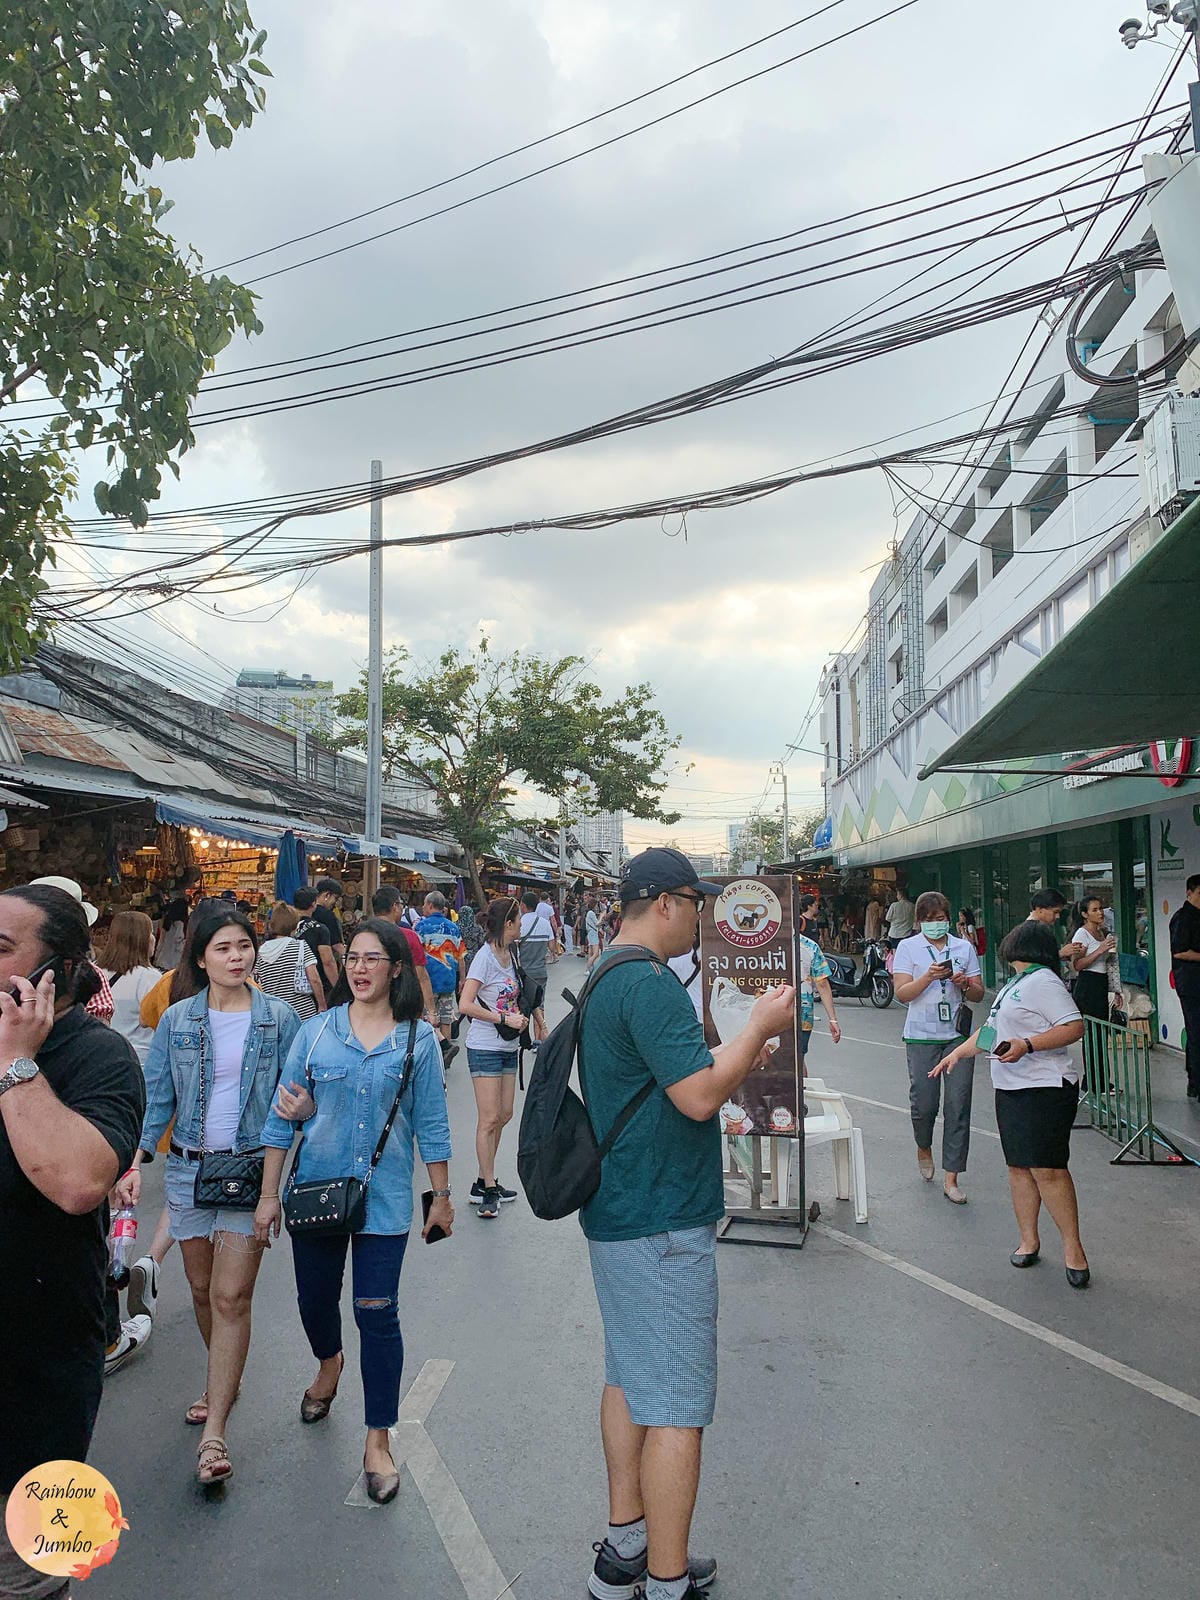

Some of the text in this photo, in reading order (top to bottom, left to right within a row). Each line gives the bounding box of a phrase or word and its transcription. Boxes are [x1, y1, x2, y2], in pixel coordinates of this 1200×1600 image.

[745, 884, 774, 903] COFFEE
[708, 956, 729, 976] ลุง
[708, 977, 745, 986] LNG
